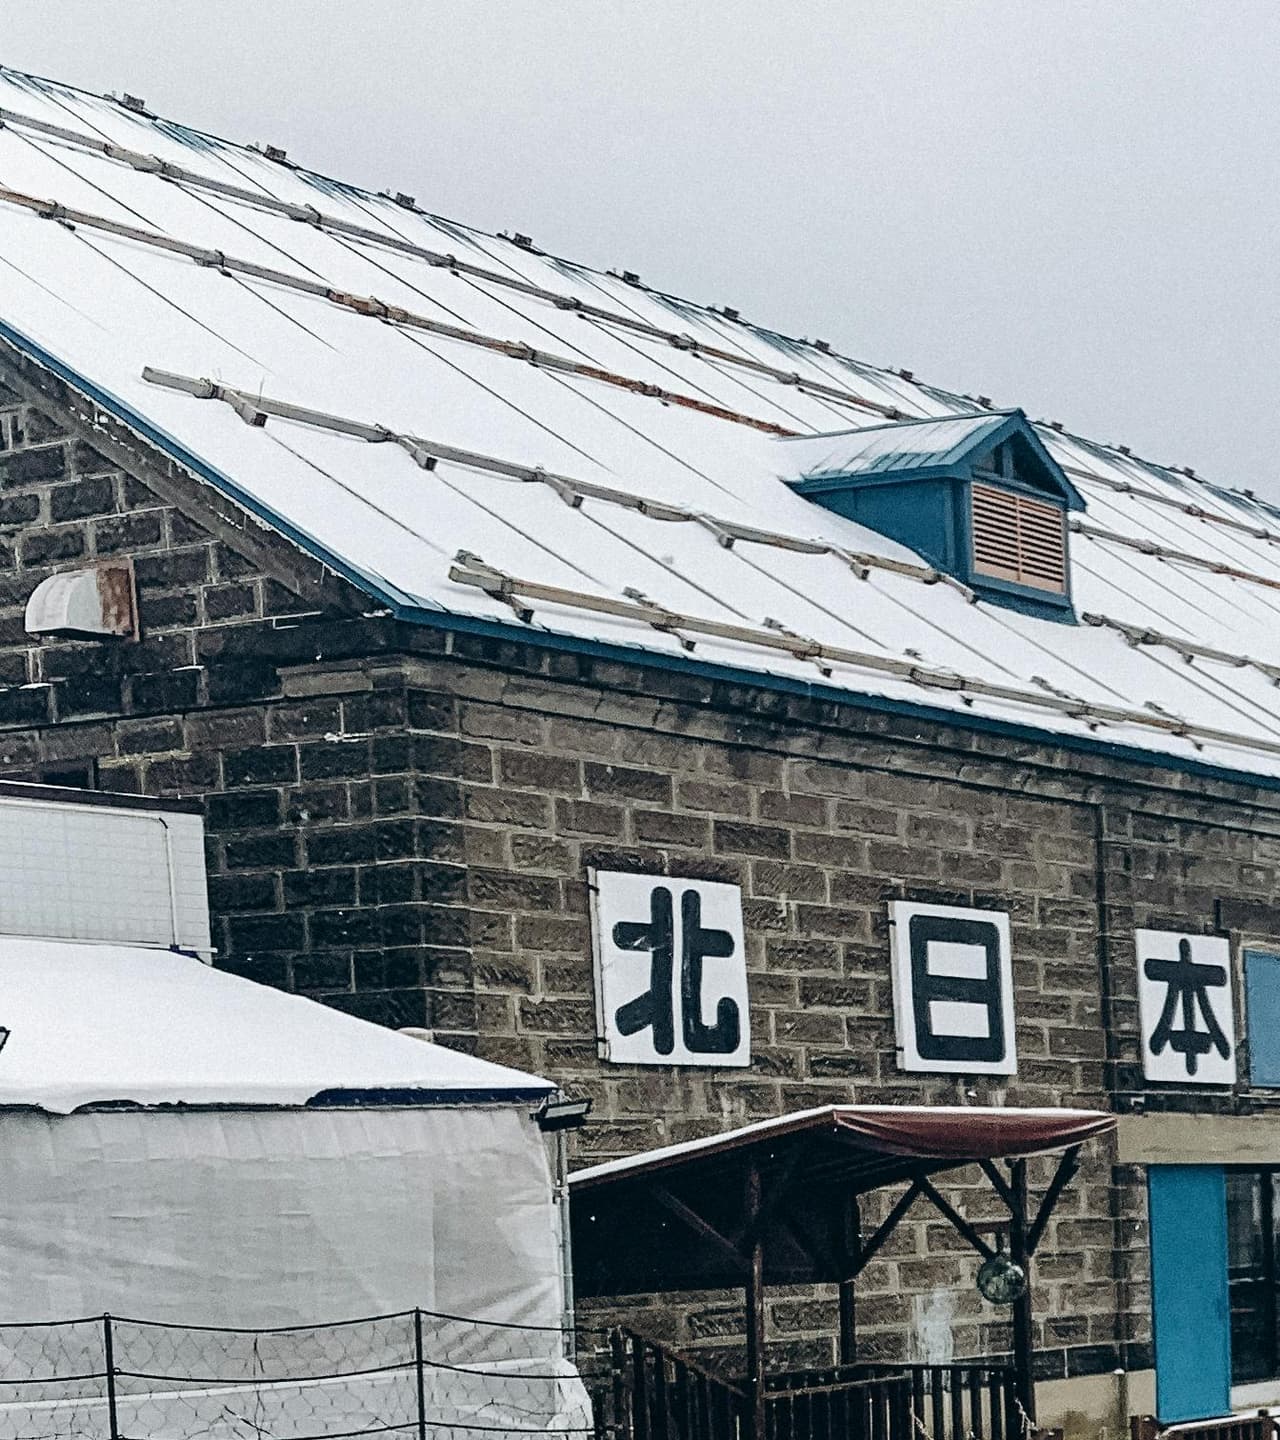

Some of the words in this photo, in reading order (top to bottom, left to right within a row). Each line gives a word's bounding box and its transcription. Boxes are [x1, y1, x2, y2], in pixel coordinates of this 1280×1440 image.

[612, 886, 740, 1055] 北
[908, 914, 1008, 1063] 日
[1143, 938, 1231, 1076] 本
